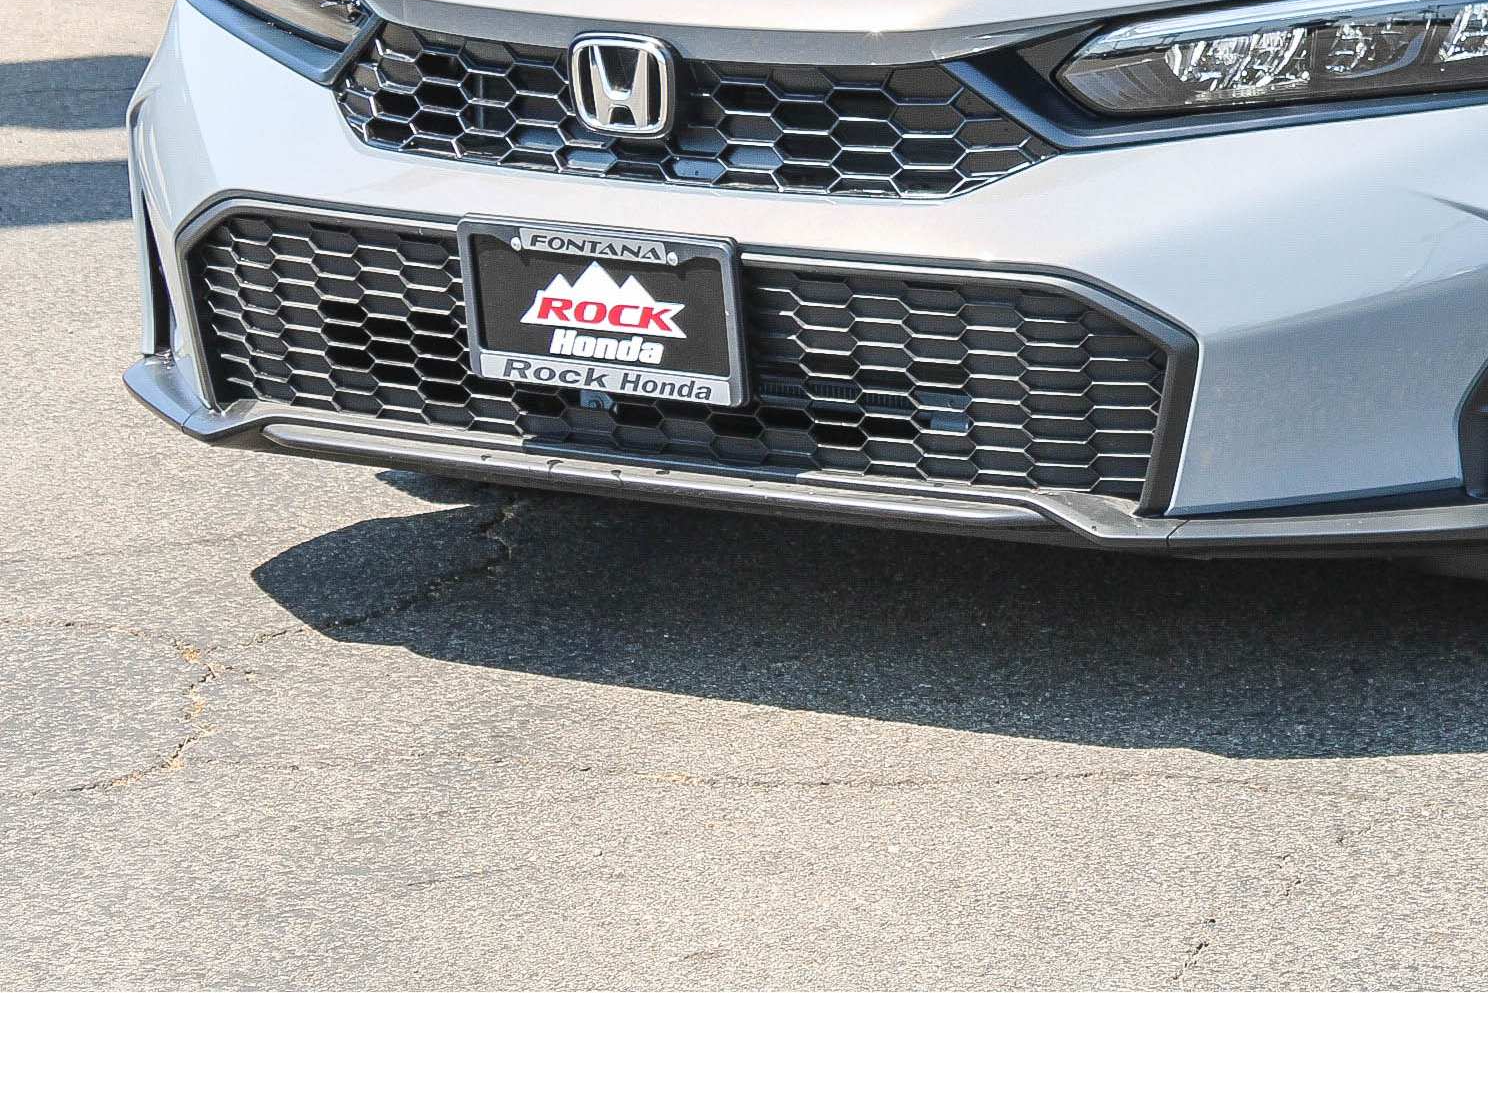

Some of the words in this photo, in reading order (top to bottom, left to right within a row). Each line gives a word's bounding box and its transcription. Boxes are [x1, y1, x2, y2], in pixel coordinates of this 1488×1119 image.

[529, 233, 663, 261] FONTANA
[536, 296, 673, 332] ROCK
[550, 328, 665, 365] Honda
[502, 358, 609, 389] Rock
[619, 372, 713, 401] Honda
